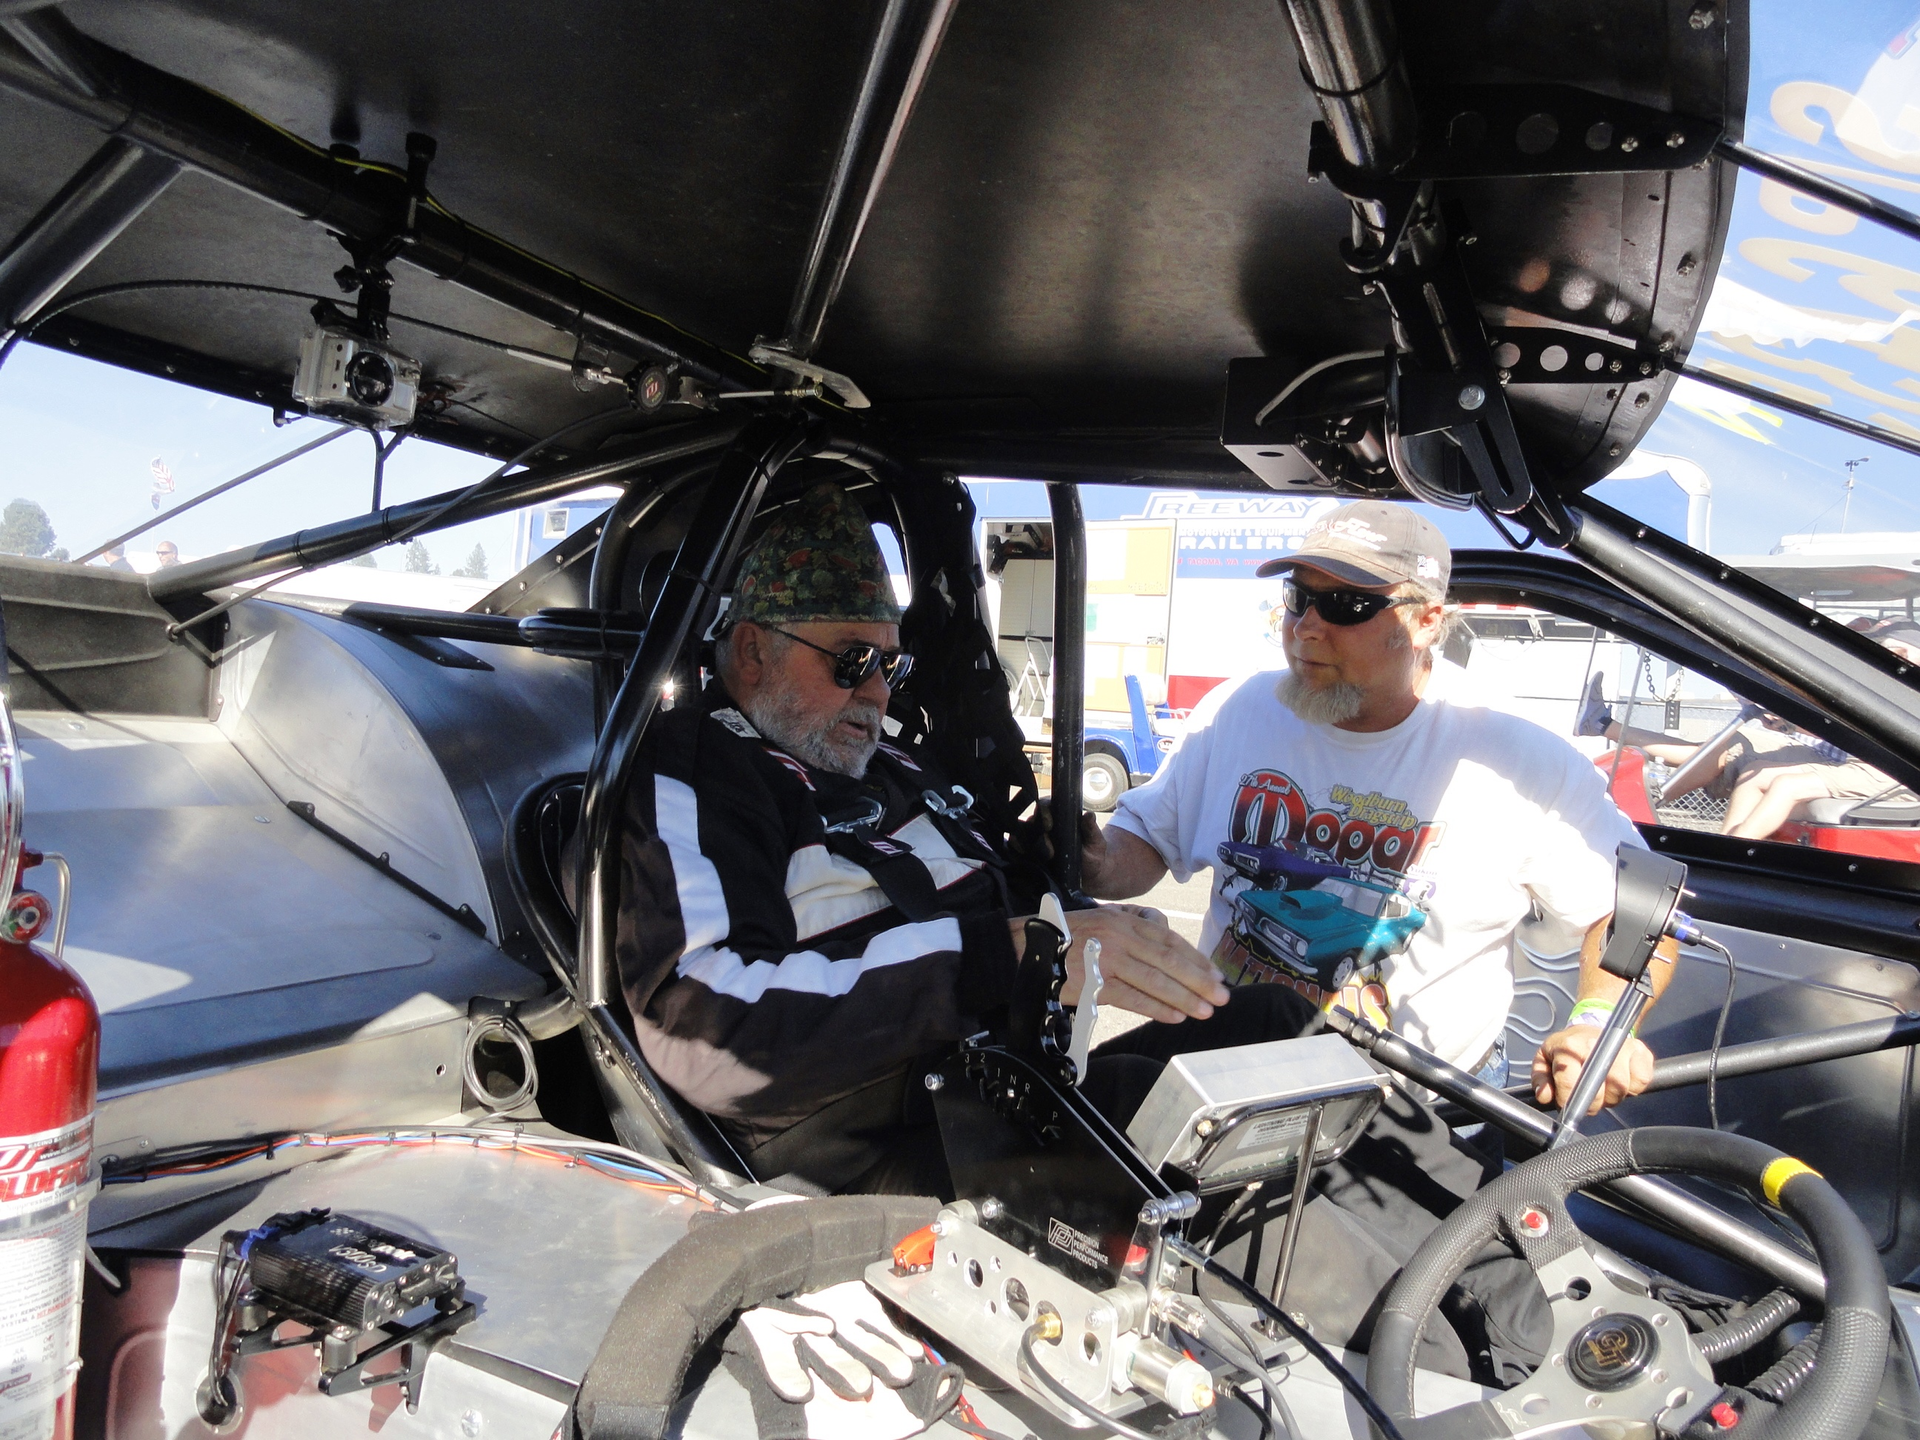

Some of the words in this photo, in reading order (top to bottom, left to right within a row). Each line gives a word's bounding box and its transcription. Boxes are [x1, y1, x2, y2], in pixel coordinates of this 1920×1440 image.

[1330, 784, 1407, 811] Woodburn
[1348, 799, 1418, 831] Dragstrip
[1072, 1249, 1099, 1269] PRODUCTS
[1073, 1239, 1109, 1265] PERFORMANCE
